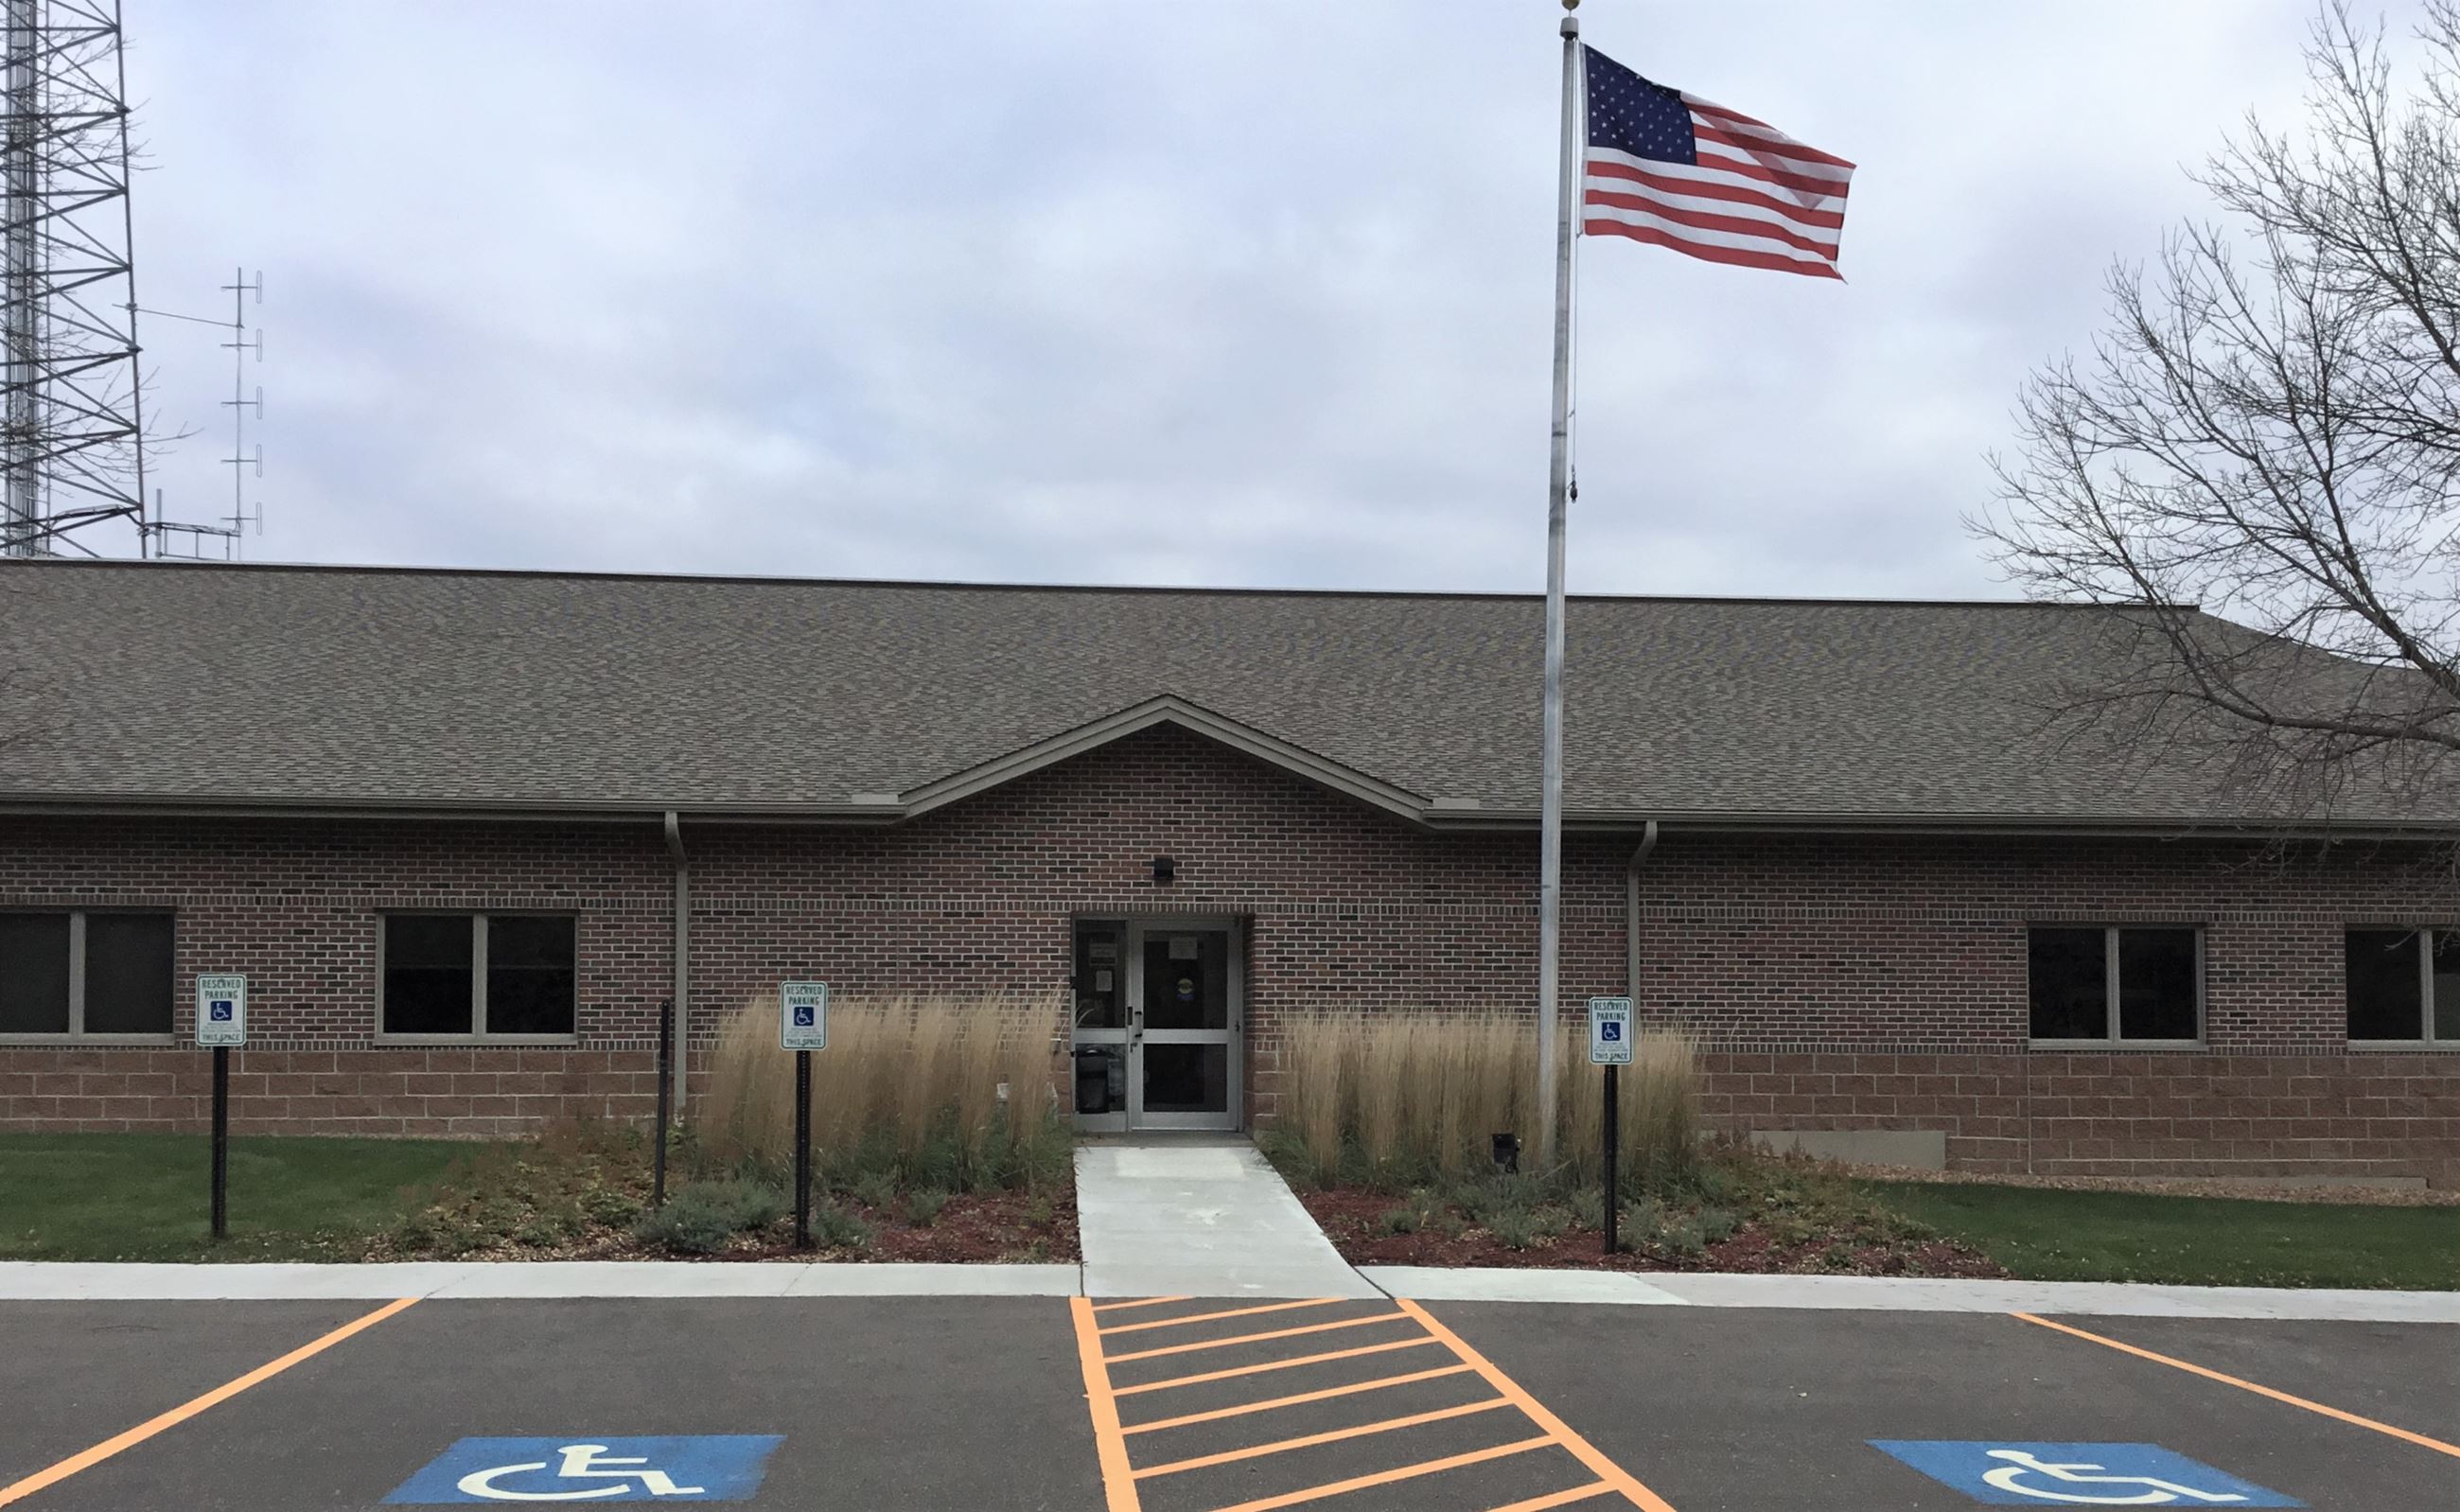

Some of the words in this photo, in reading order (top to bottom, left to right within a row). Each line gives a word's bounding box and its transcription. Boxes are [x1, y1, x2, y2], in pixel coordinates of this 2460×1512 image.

[202, 978, 241, 989] RESERVED
[204, 990, 238, 999] PARKING
[785, 985, 823, 994] RESERVED
[788, 995, 819, 1005] PARKING
[1593, 1001, 1628, 1011] RESERVED
[1596, 1011, 1625, 1021] PARKING
